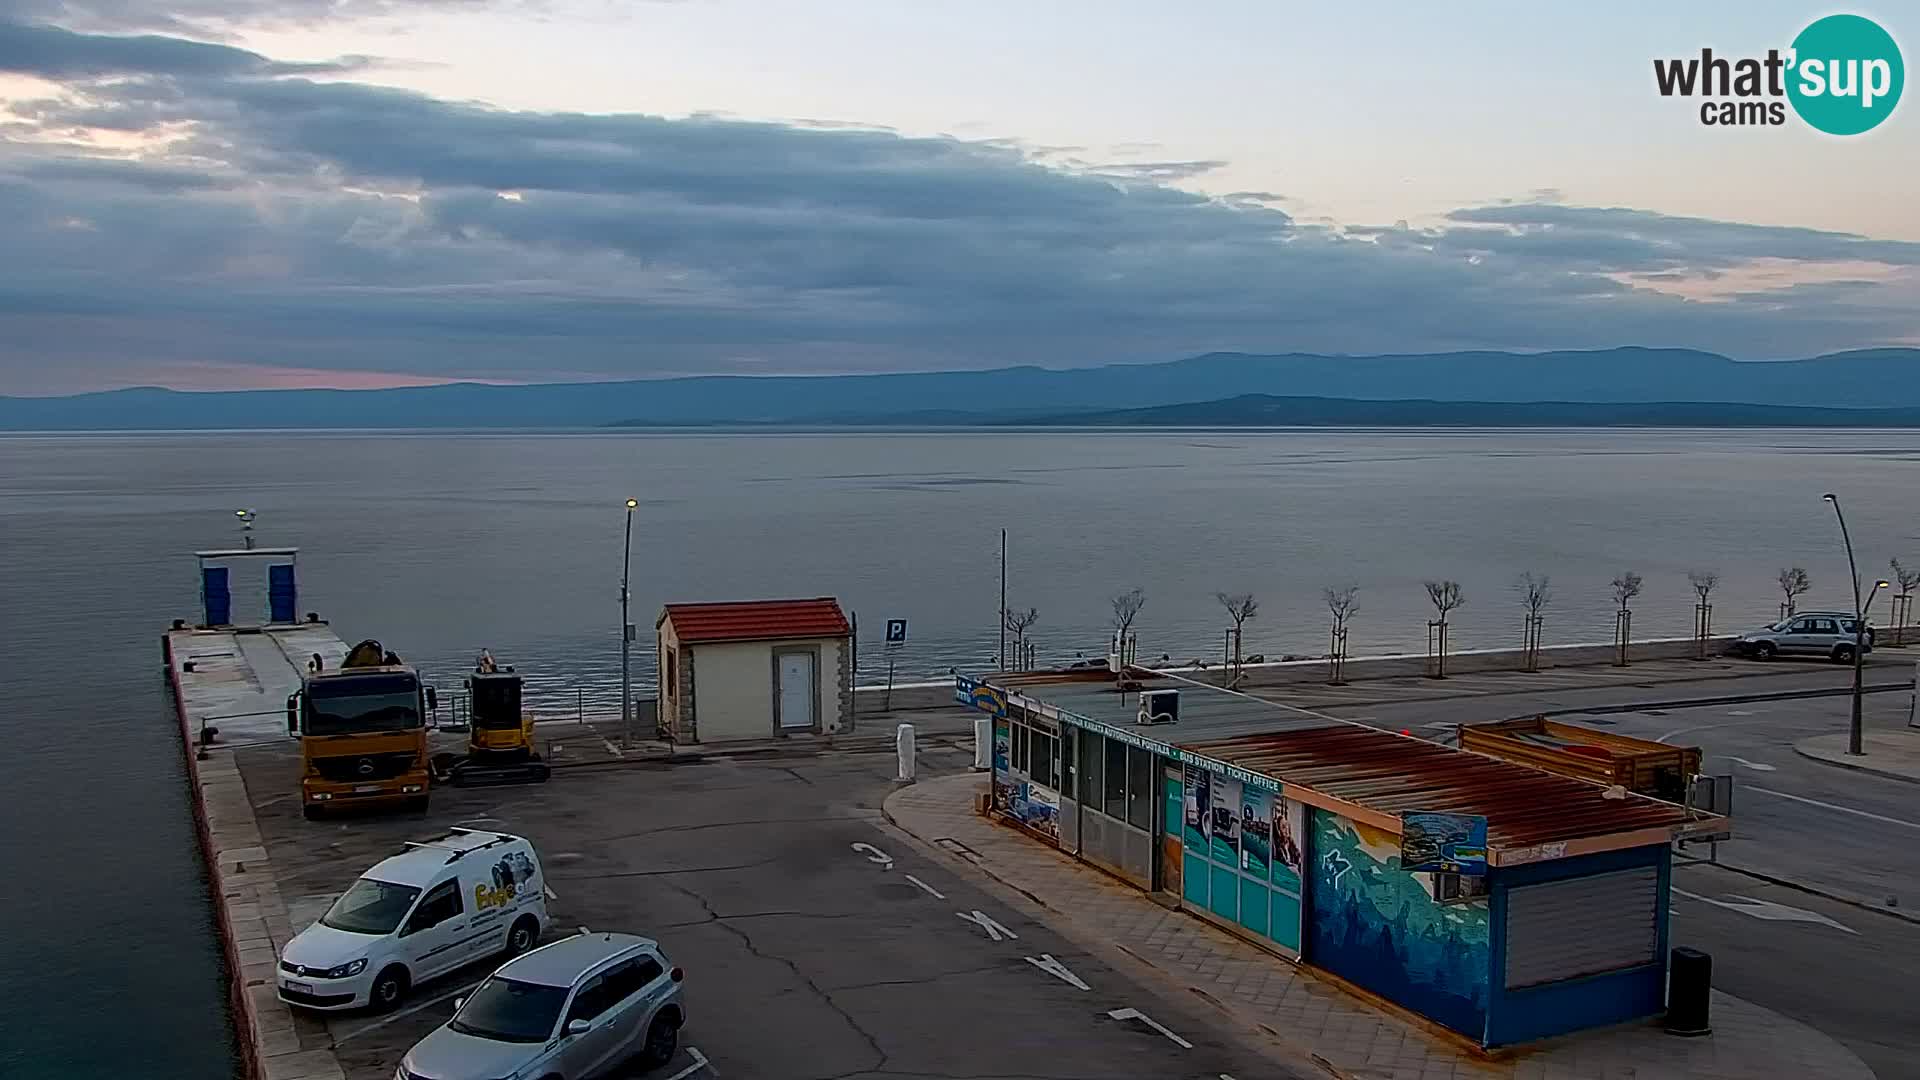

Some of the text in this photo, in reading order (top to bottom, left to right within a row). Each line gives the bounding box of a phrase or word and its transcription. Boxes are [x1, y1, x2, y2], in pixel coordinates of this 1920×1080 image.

[890, 622, 902, 639] P
[1141, 738, 1170, 756] POSTAJA
[1179, 751, 1194, 765] BUS
[1194, 756, 1225, 775] STATION
[1227, 766, 1251, 784] TICKET
[1252, 775, 1279, 792] OFFICE
